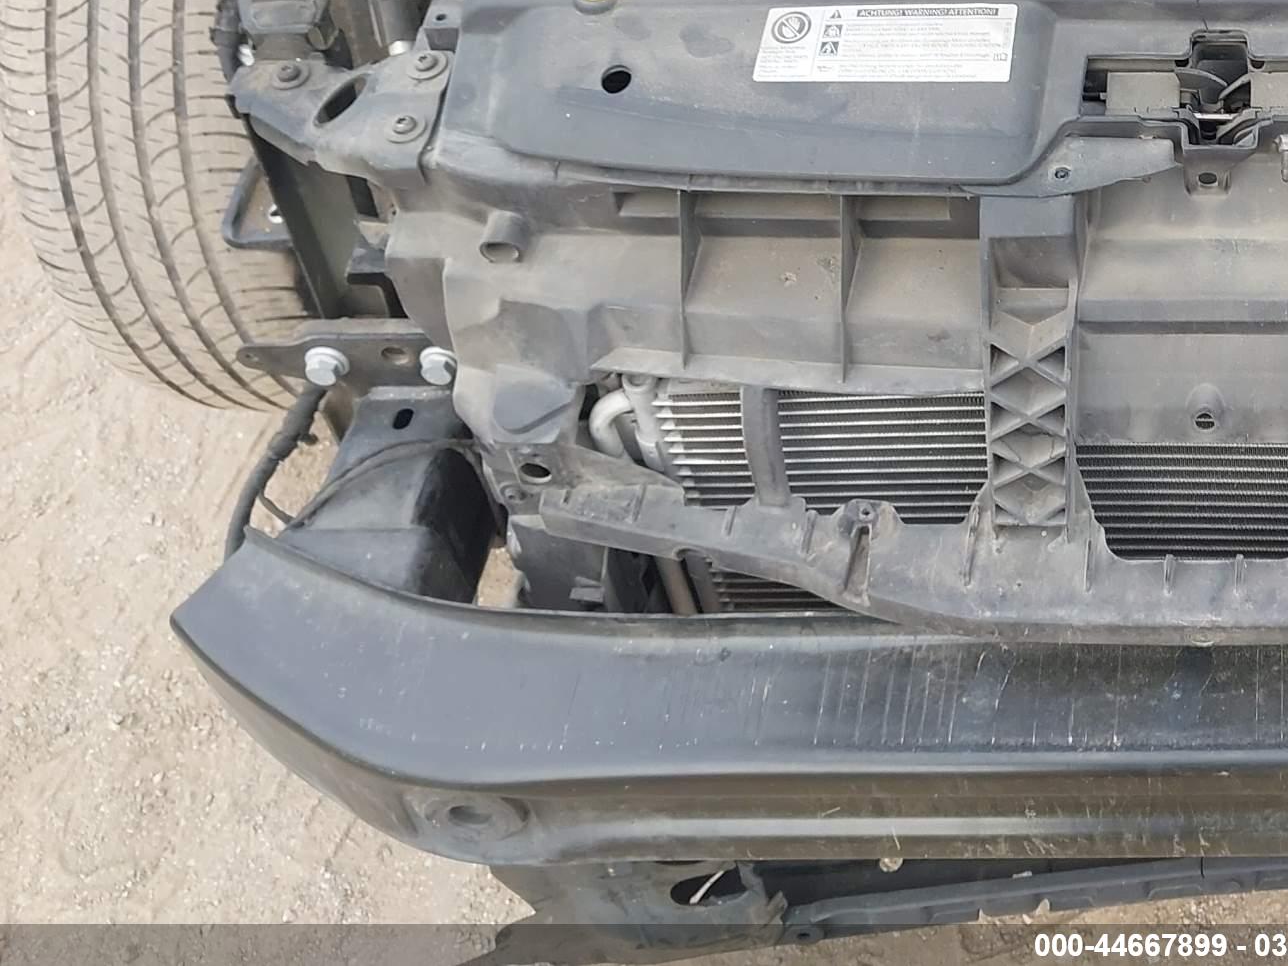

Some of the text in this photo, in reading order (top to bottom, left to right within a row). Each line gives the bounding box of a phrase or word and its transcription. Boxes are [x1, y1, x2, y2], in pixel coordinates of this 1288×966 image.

[858, 7, 996, 18] ACHTUNG! WARNING! ATTENTION!
